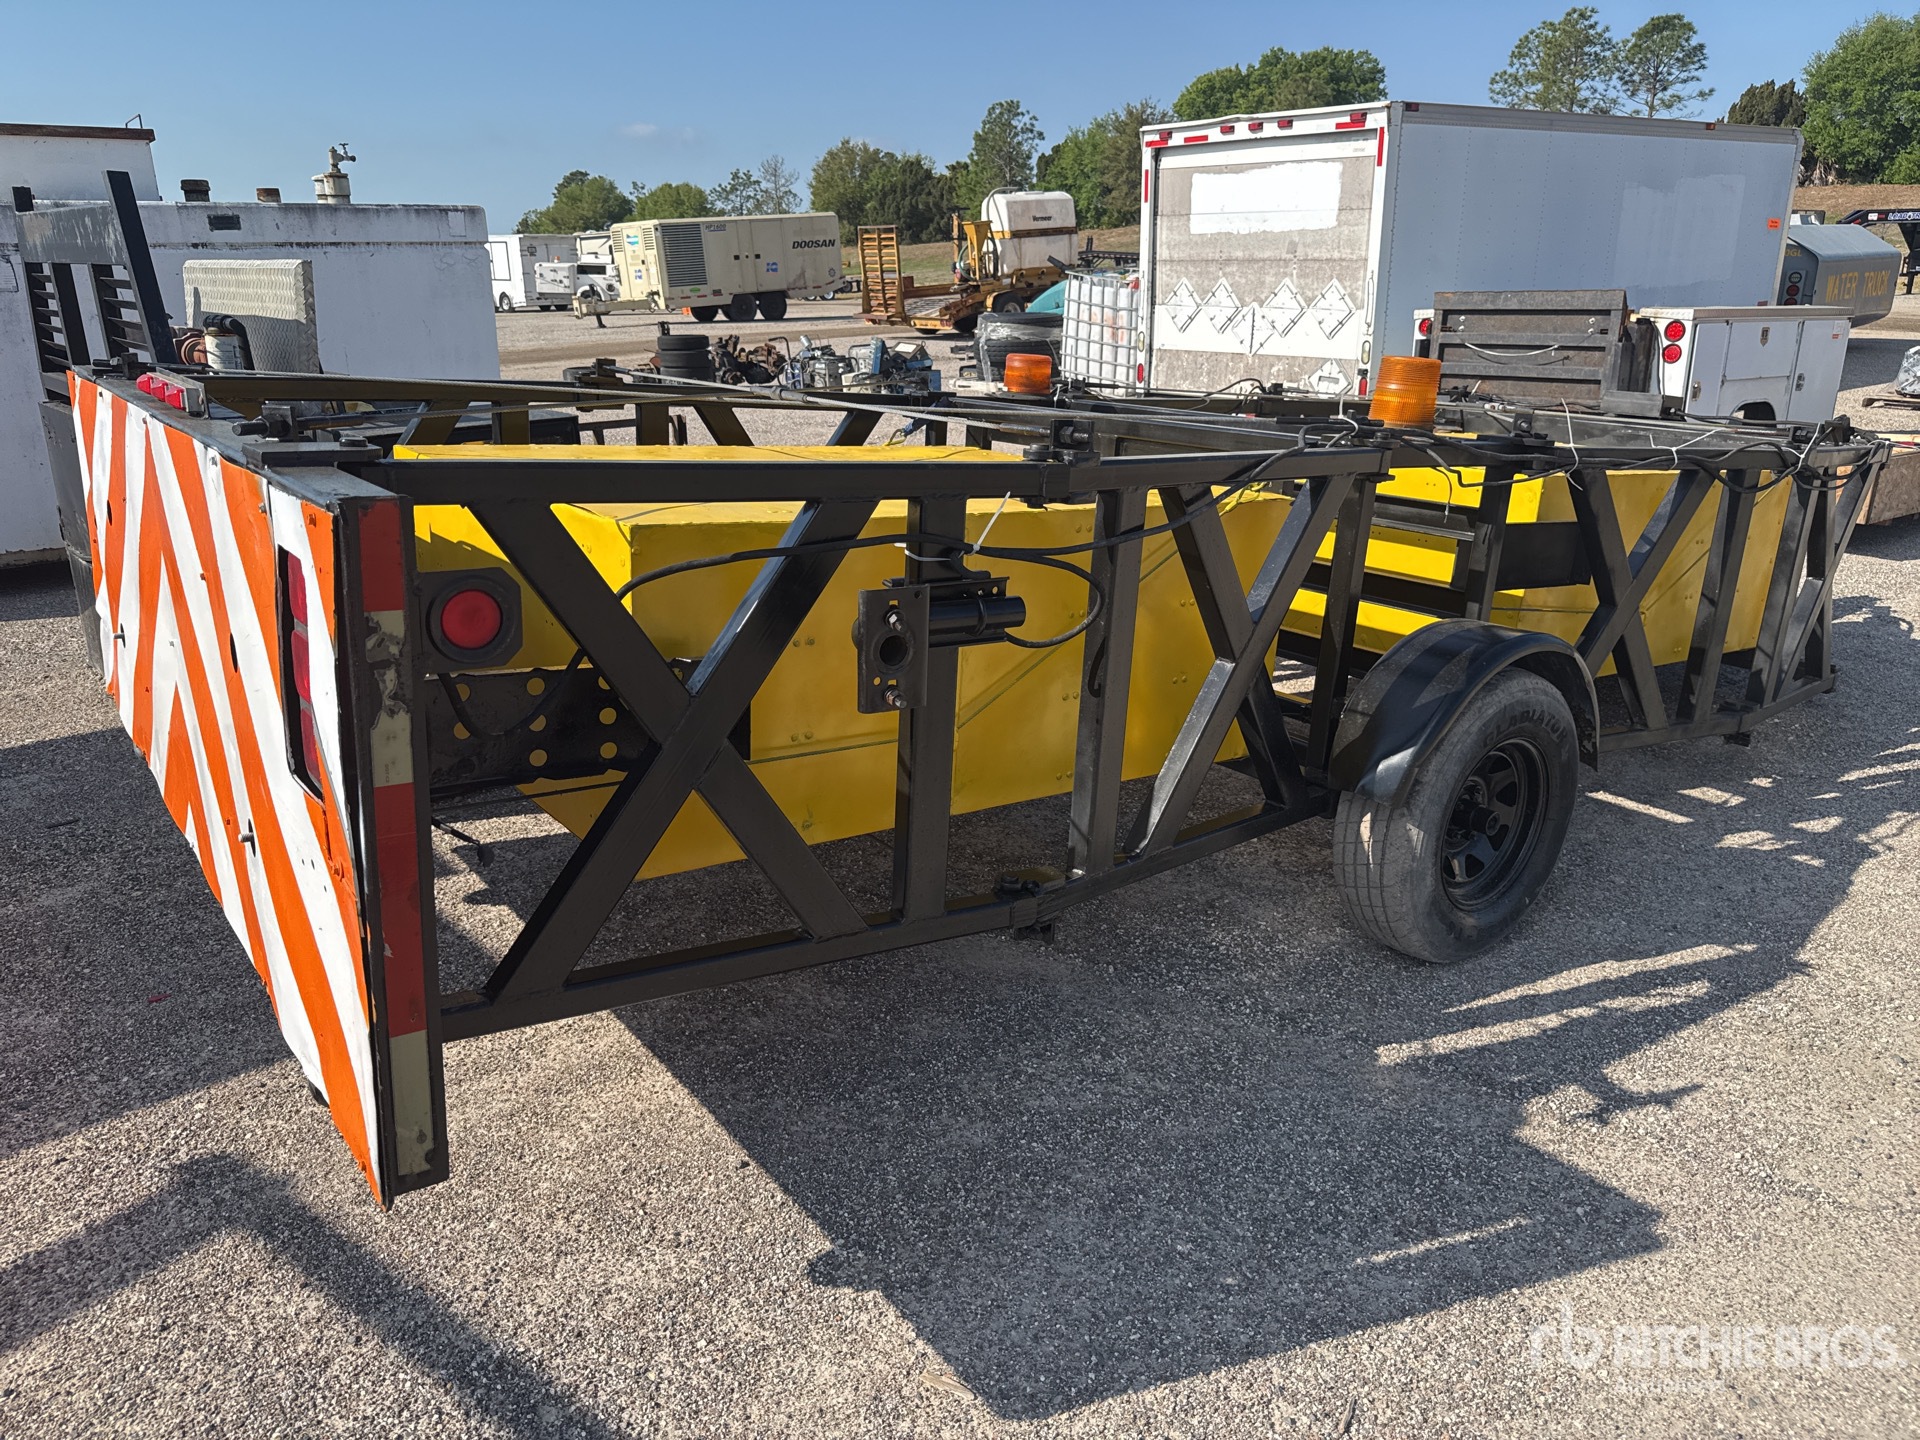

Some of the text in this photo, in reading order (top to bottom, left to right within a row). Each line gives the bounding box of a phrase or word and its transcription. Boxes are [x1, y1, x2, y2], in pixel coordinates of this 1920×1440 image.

[705, 222, 727, 231] HP1600
[792, 239, 836, 249] DOOSAN
[1825, 269, 1891, 304] WATER TRUCK
